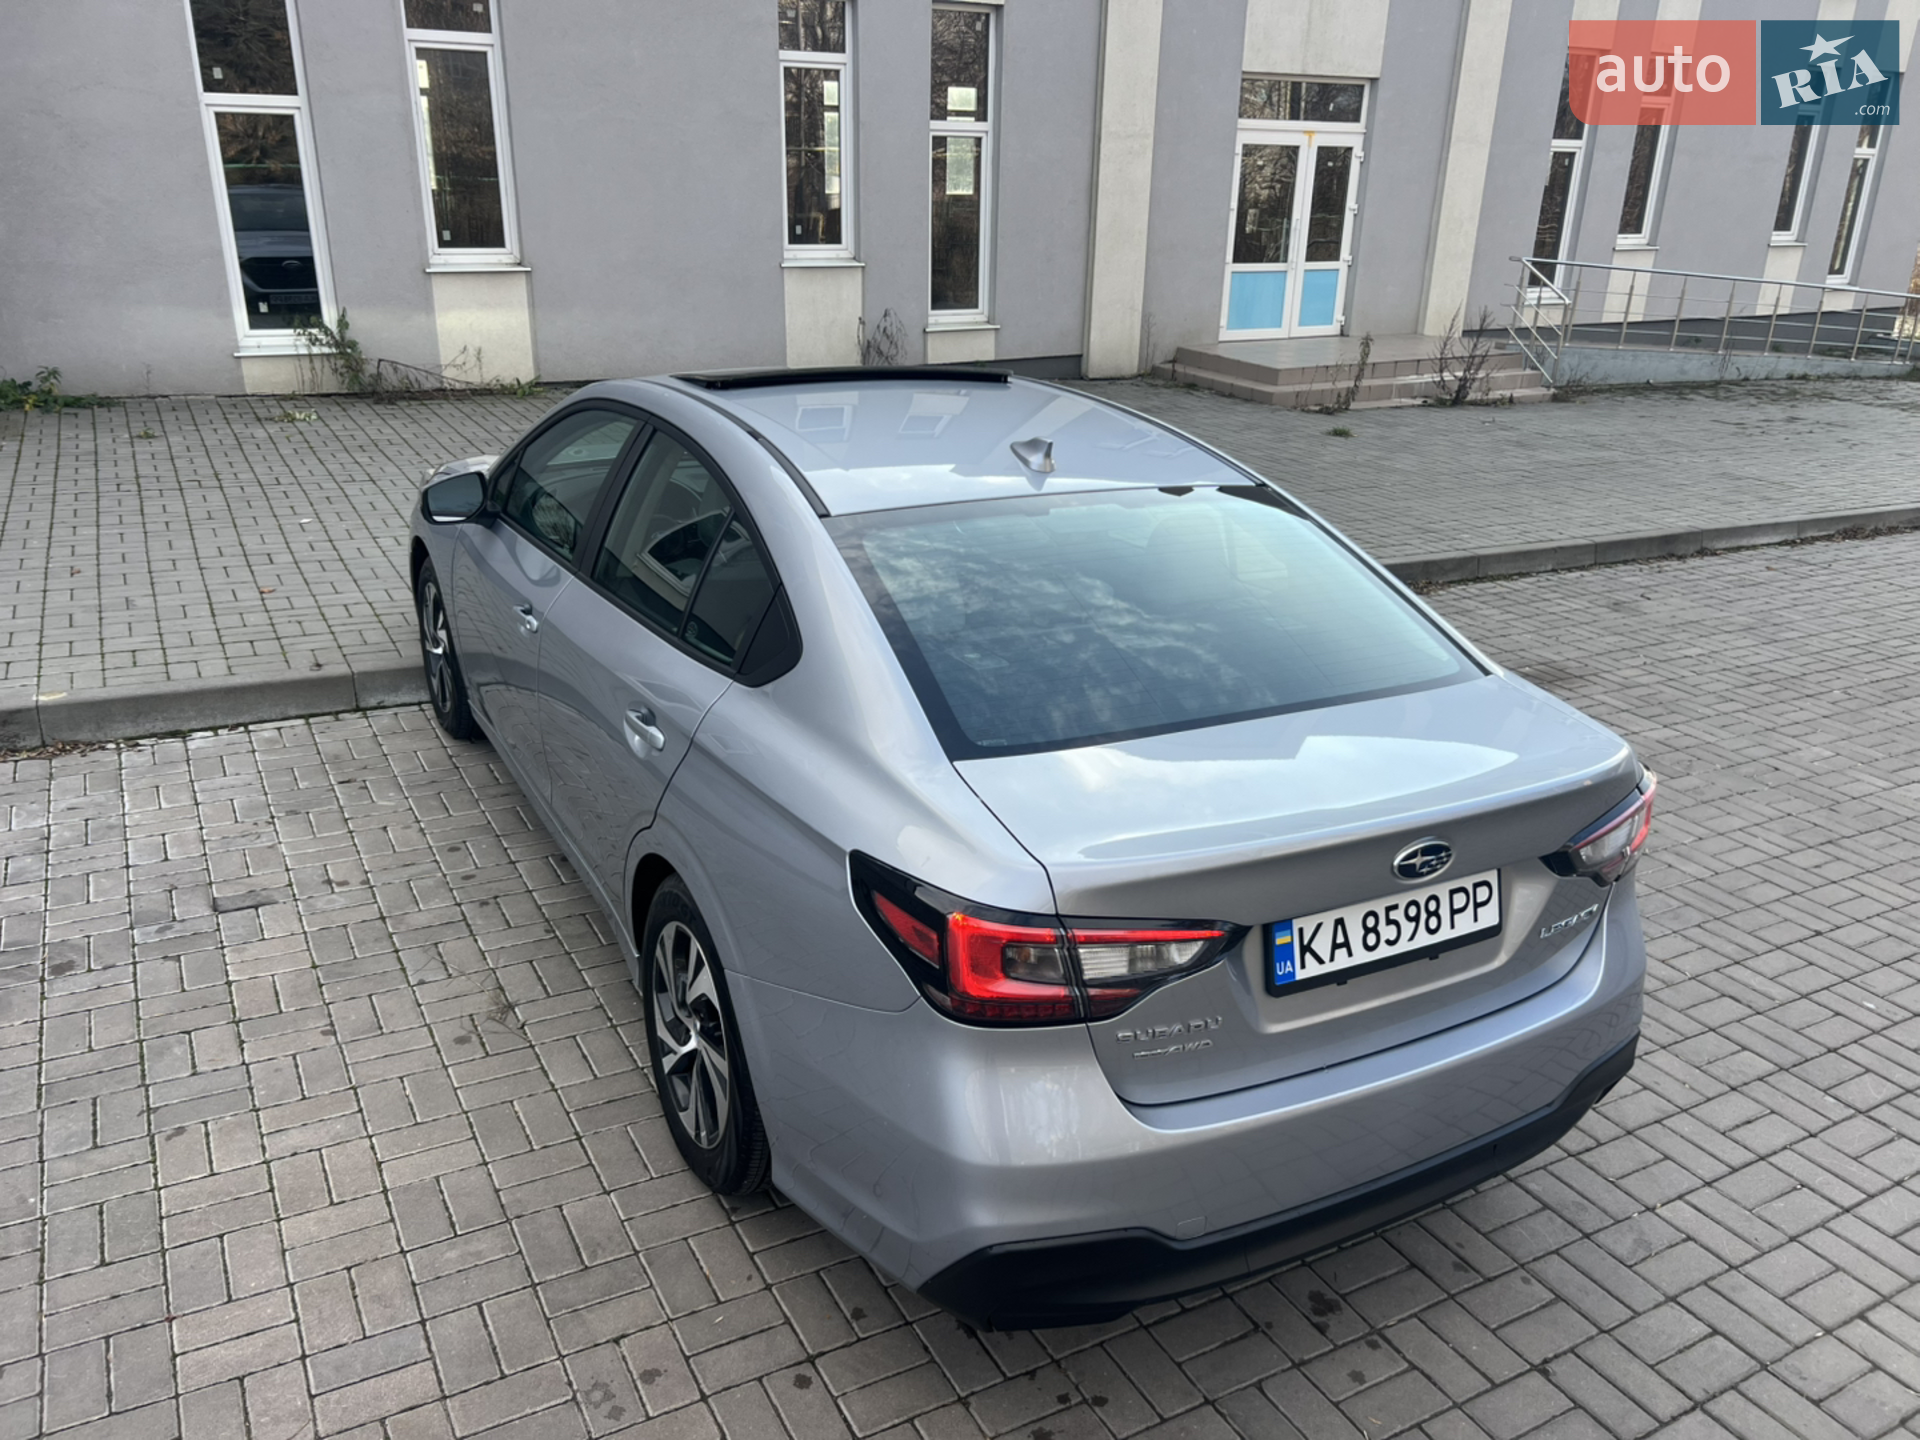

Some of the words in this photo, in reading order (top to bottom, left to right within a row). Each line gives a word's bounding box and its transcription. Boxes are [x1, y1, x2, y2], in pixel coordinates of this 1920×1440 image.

[1297, 916, 1354, 970] KA
[1361, 893, 1442, 953] 8598
[1447, 879, 1493, 930] PP
[1276, 960, 1294, 976] UA
[1116, 1015, 1223, 1043] SUBARU
